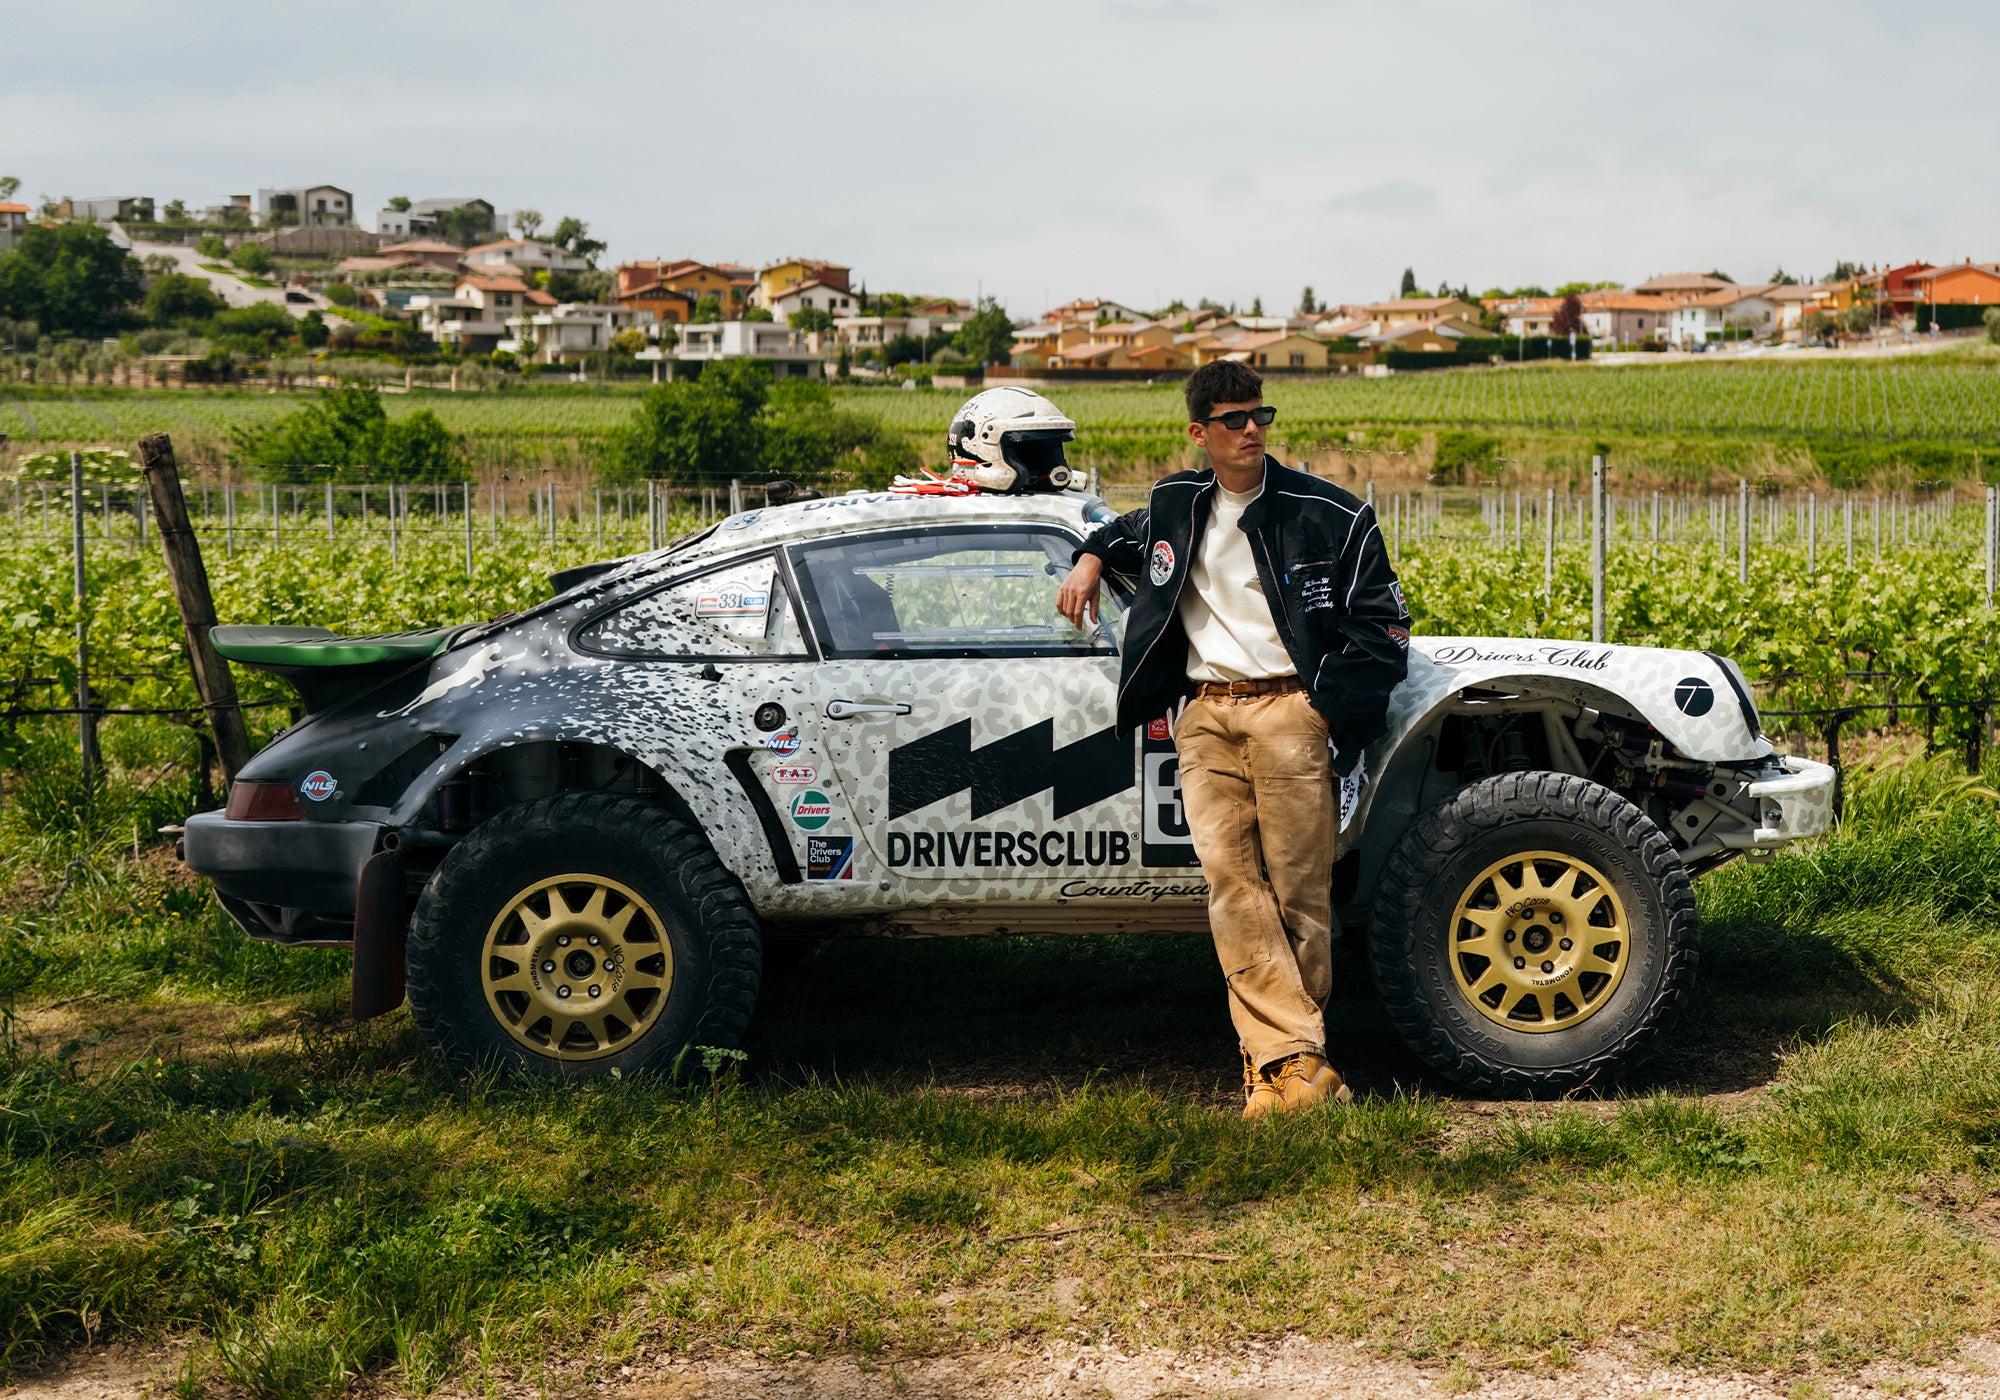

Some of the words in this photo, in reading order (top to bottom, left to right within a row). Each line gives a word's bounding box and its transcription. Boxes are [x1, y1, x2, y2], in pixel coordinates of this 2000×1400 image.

[718, 593, 743, 609] 331
[1433, 646, 1538, 665] Drivers
[1538, 646, 1614, 671] Club
[767, 739, 801, 749] NILS
[303, 781, 335, 791] NILS
[796, 805, 831, 815] Drivers
[809, 840, 827, 848] The
[809, 848, 842, 856] Drivers
[809, 855, 831, 863] Club
[1060, 880, 1210, 903] Countrysid
[530, 943, 544, 992] FONDMETAL
[1530, 965, 1574, 986] FONDMETAL
